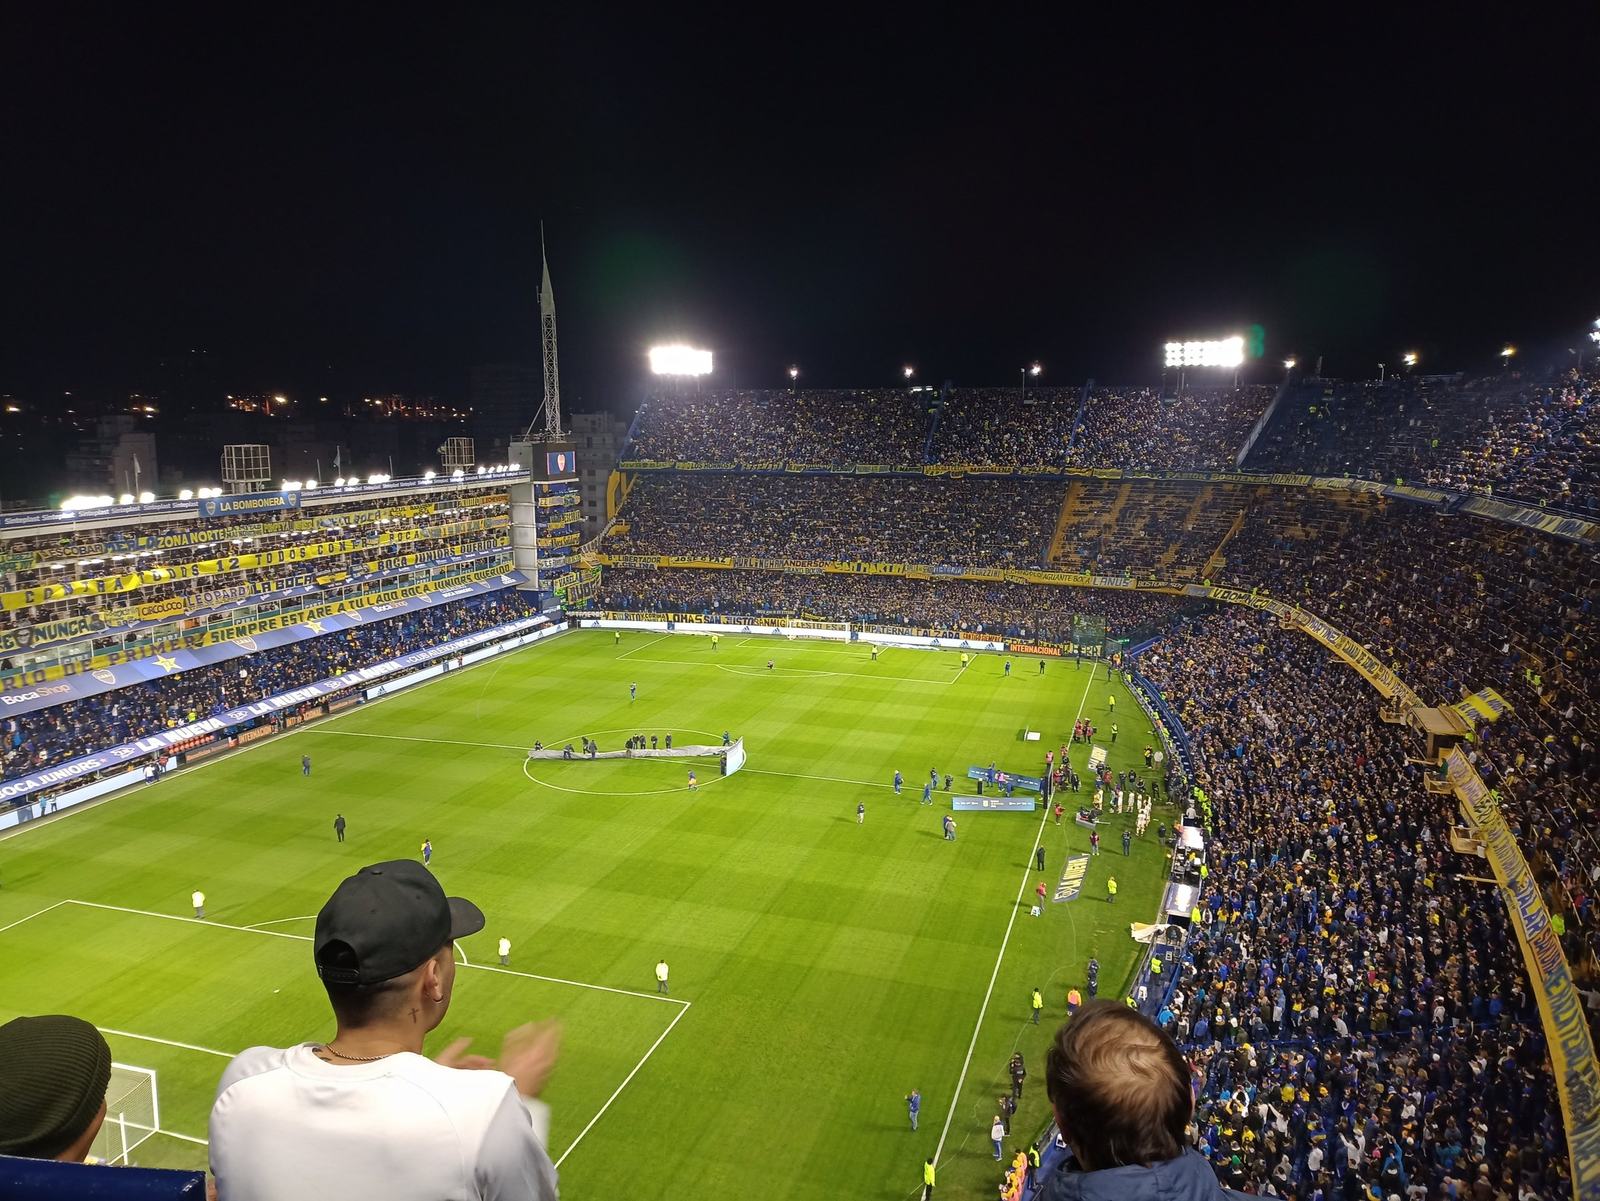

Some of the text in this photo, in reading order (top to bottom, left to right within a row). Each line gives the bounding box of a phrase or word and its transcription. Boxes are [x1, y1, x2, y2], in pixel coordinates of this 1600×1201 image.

[220, 496, 285, 512] LA BOMBONERA
[158, 535, 188, 549] ZONA
[190, 529, 224, 543] NORTE
[49, 544, 103, 557] ESCOBAR
[378, 540, 498, 570] BOCA JUNIORS QUERIDO
[25, 577, 124, 603] CONTRA
[139, 563, 200, 582] TODOS
[216, 557, 240, 572] 12
[255, 547, 306, 566] TODOS
[389, 529, 420, 541] BOCA
[784, 560, 833, 568] ANDERSON
[251, 576, 314, 594] LA BOCA
[1042, 573, 1072, 581] AGUANTE
[1073, 575, 1091, 584] BOCA
[1093, 577, 1132, 588] LANUS
[211, 564, 510, 643] SIEMPRE ESTARE A TU LADO BOCA JUNIORS QUERIDO
[666, 613, 703, 624] LOMAS
[34, 619, 90, 641] NUNCA
[408, 651, 429, 664] CLUB
[1010, 643, 1062, 657] INTERNACIONAL
[341, 660, 403, 685] LA NUEVA
[1, 684, 71, 705] BocaShop
[247, 686, 323, 715] LA NUEVA
[135, 716, 227, 752] LA NUEVA
[38, 758, 101, 785] JUNIORS
